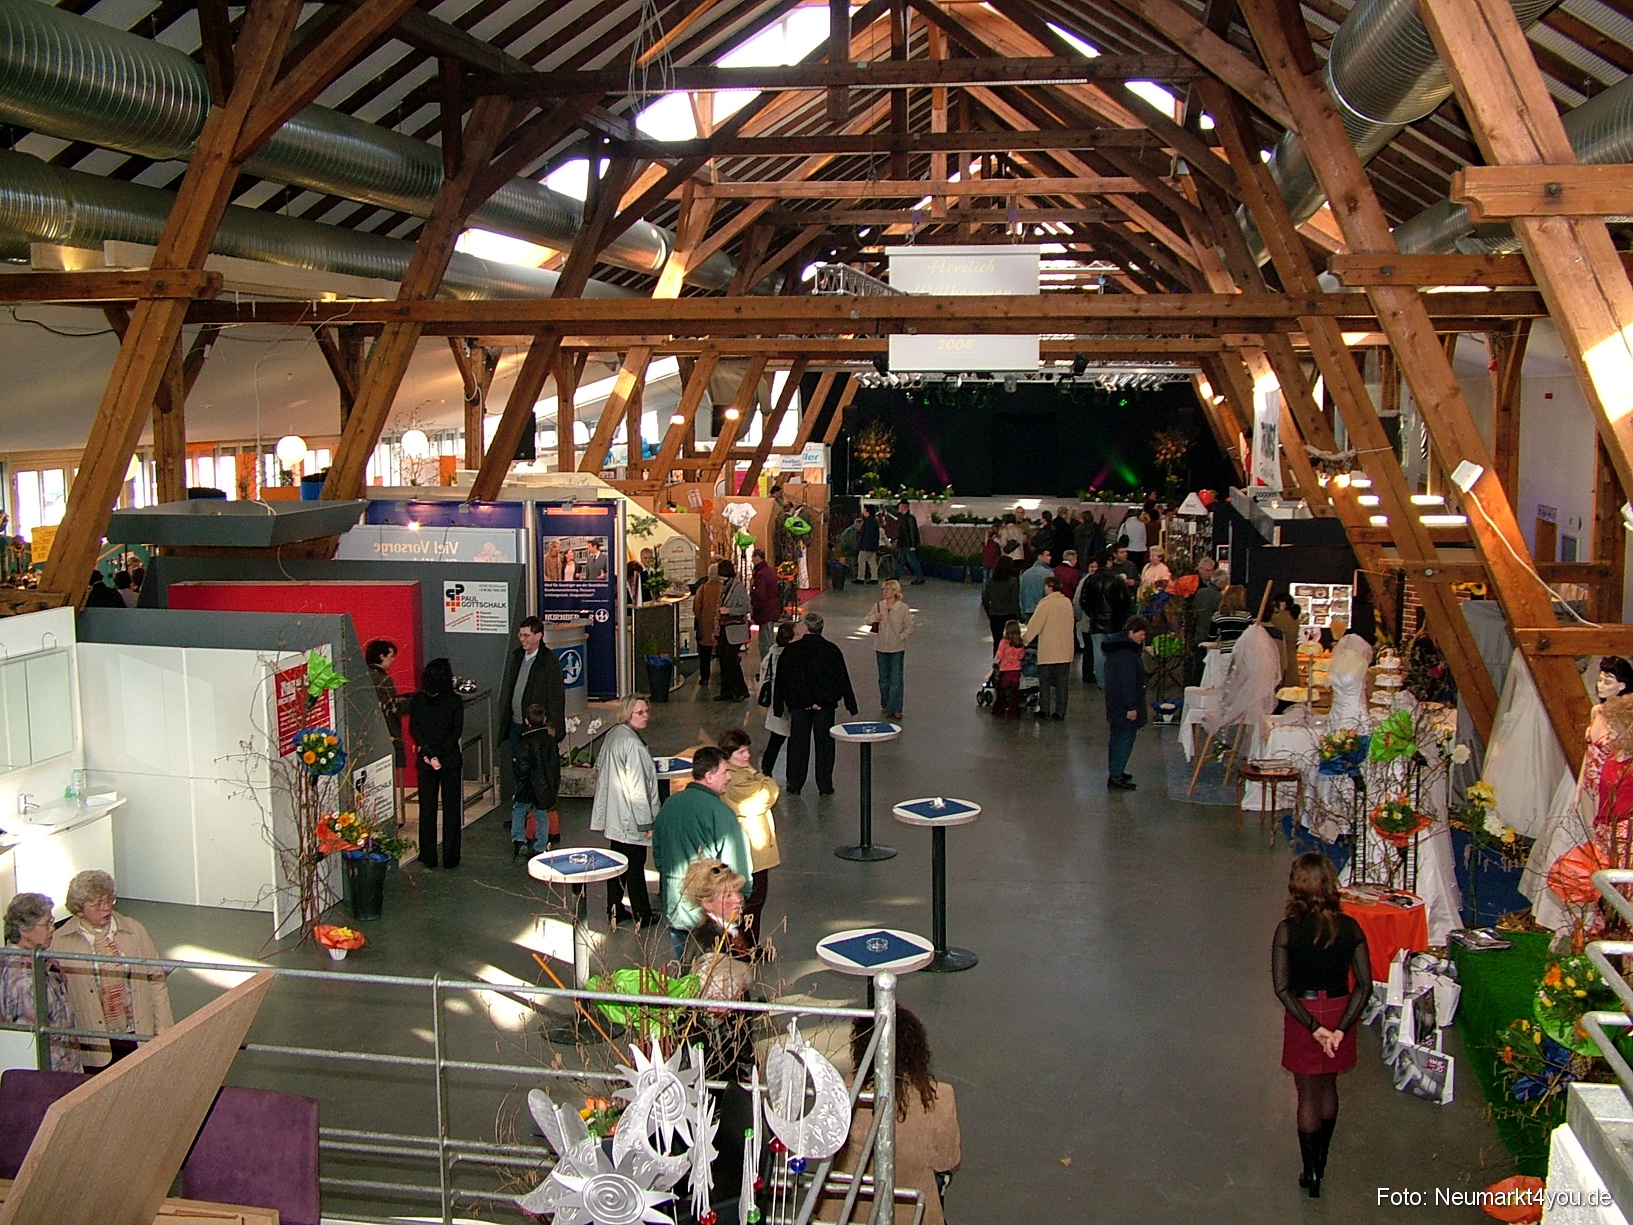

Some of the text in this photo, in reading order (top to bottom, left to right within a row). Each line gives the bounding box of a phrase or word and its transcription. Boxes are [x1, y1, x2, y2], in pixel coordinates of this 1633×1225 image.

[928, 258, 996, 275] Herzlich
[936, 338, 975, 352] 2004
[461, 601, 507, 609] GOTTSCHALK
[544, 613, 595, 621] NÜRNBERR
